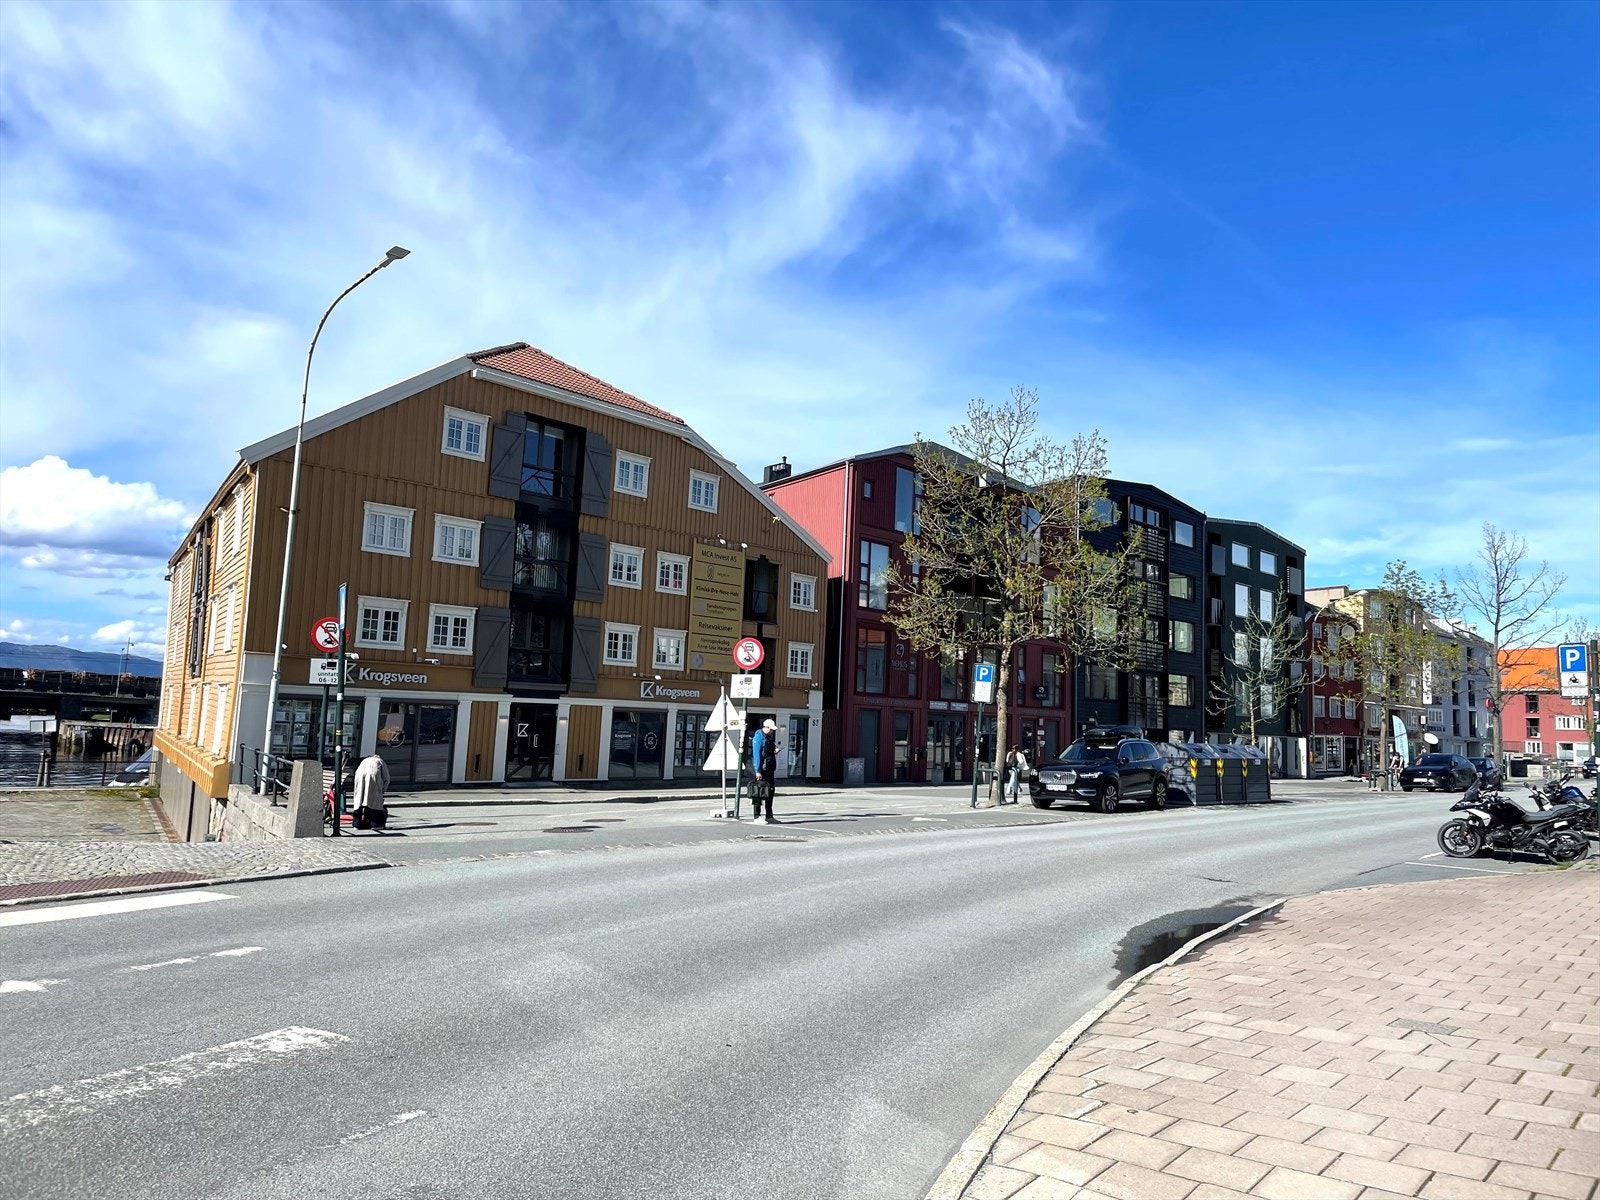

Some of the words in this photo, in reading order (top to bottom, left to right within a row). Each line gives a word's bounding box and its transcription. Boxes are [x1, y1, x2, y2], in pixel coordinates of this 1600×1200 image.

[702, 550, 713, 558] MCA
[715, 552, 730, 561] Invest
[1565, 649, 1580, 669] P
[359, 667, 428, 685] Krogsveen
[980, 667, 989, 680] P
[655, 685, 700, 699] Krogsveen
